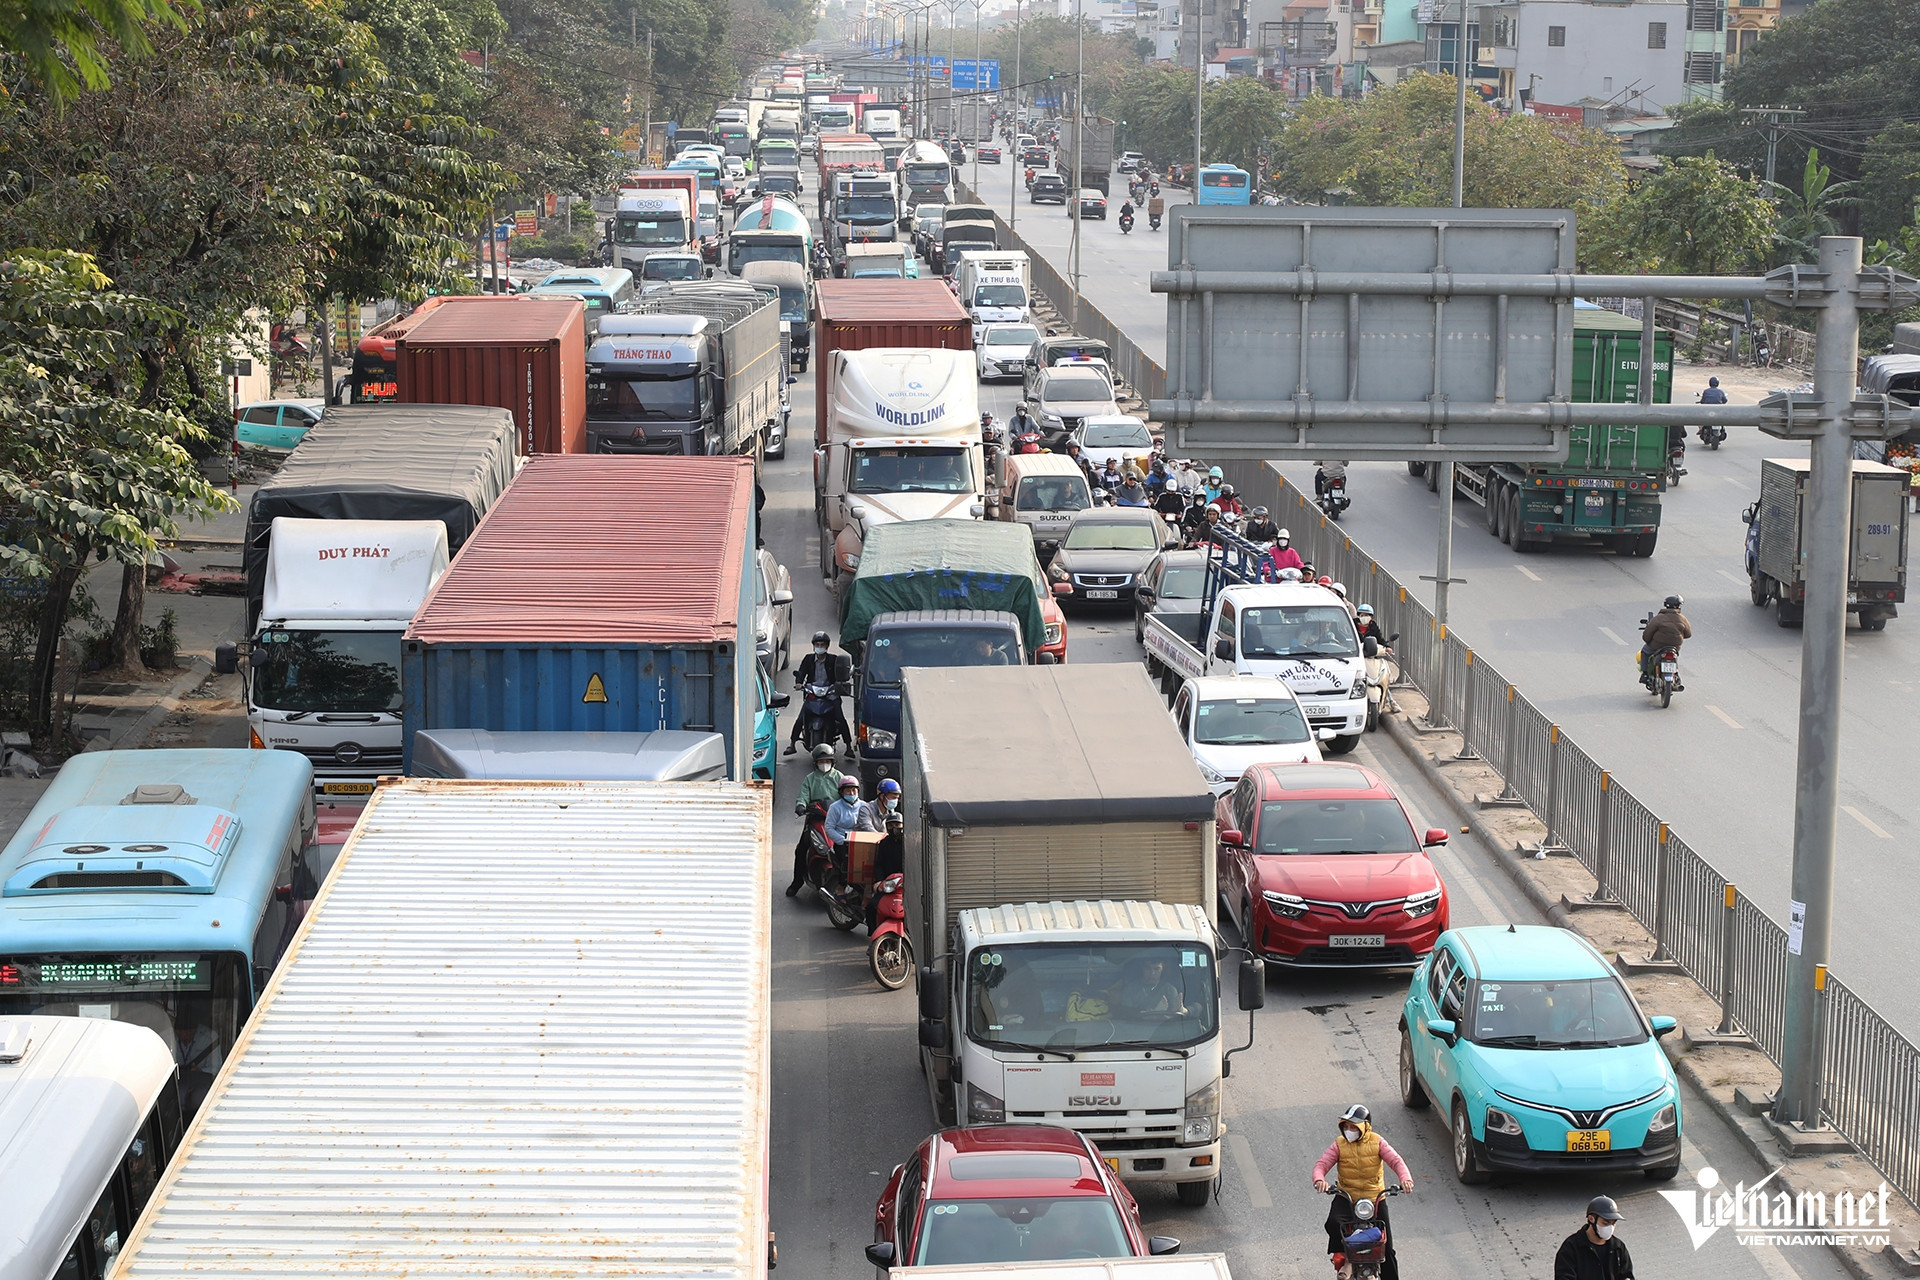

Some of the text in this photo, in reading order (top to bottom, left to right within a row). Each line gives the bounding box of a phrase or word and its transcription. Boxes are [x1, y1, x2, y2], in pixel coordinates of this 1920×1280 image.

[1621, 361, 1639, 370] EITU
[875, 402, 945, 426] WORLDLINK
[318, 547, 348, 560] DUY
[1319, 667, 1342, 688] CONG
[327, 784, 369, 792] 89C-099.00
[1333, 936, 1381, 946] 30K-124.26
[1481, 1004, 1504, 1012] TAXI
[1068, 1096, 1122, 1106] ISUZU
[1579, 1131, 1598, 1141] 29E
[1571, 1141, 1606, 1151] 068.50
